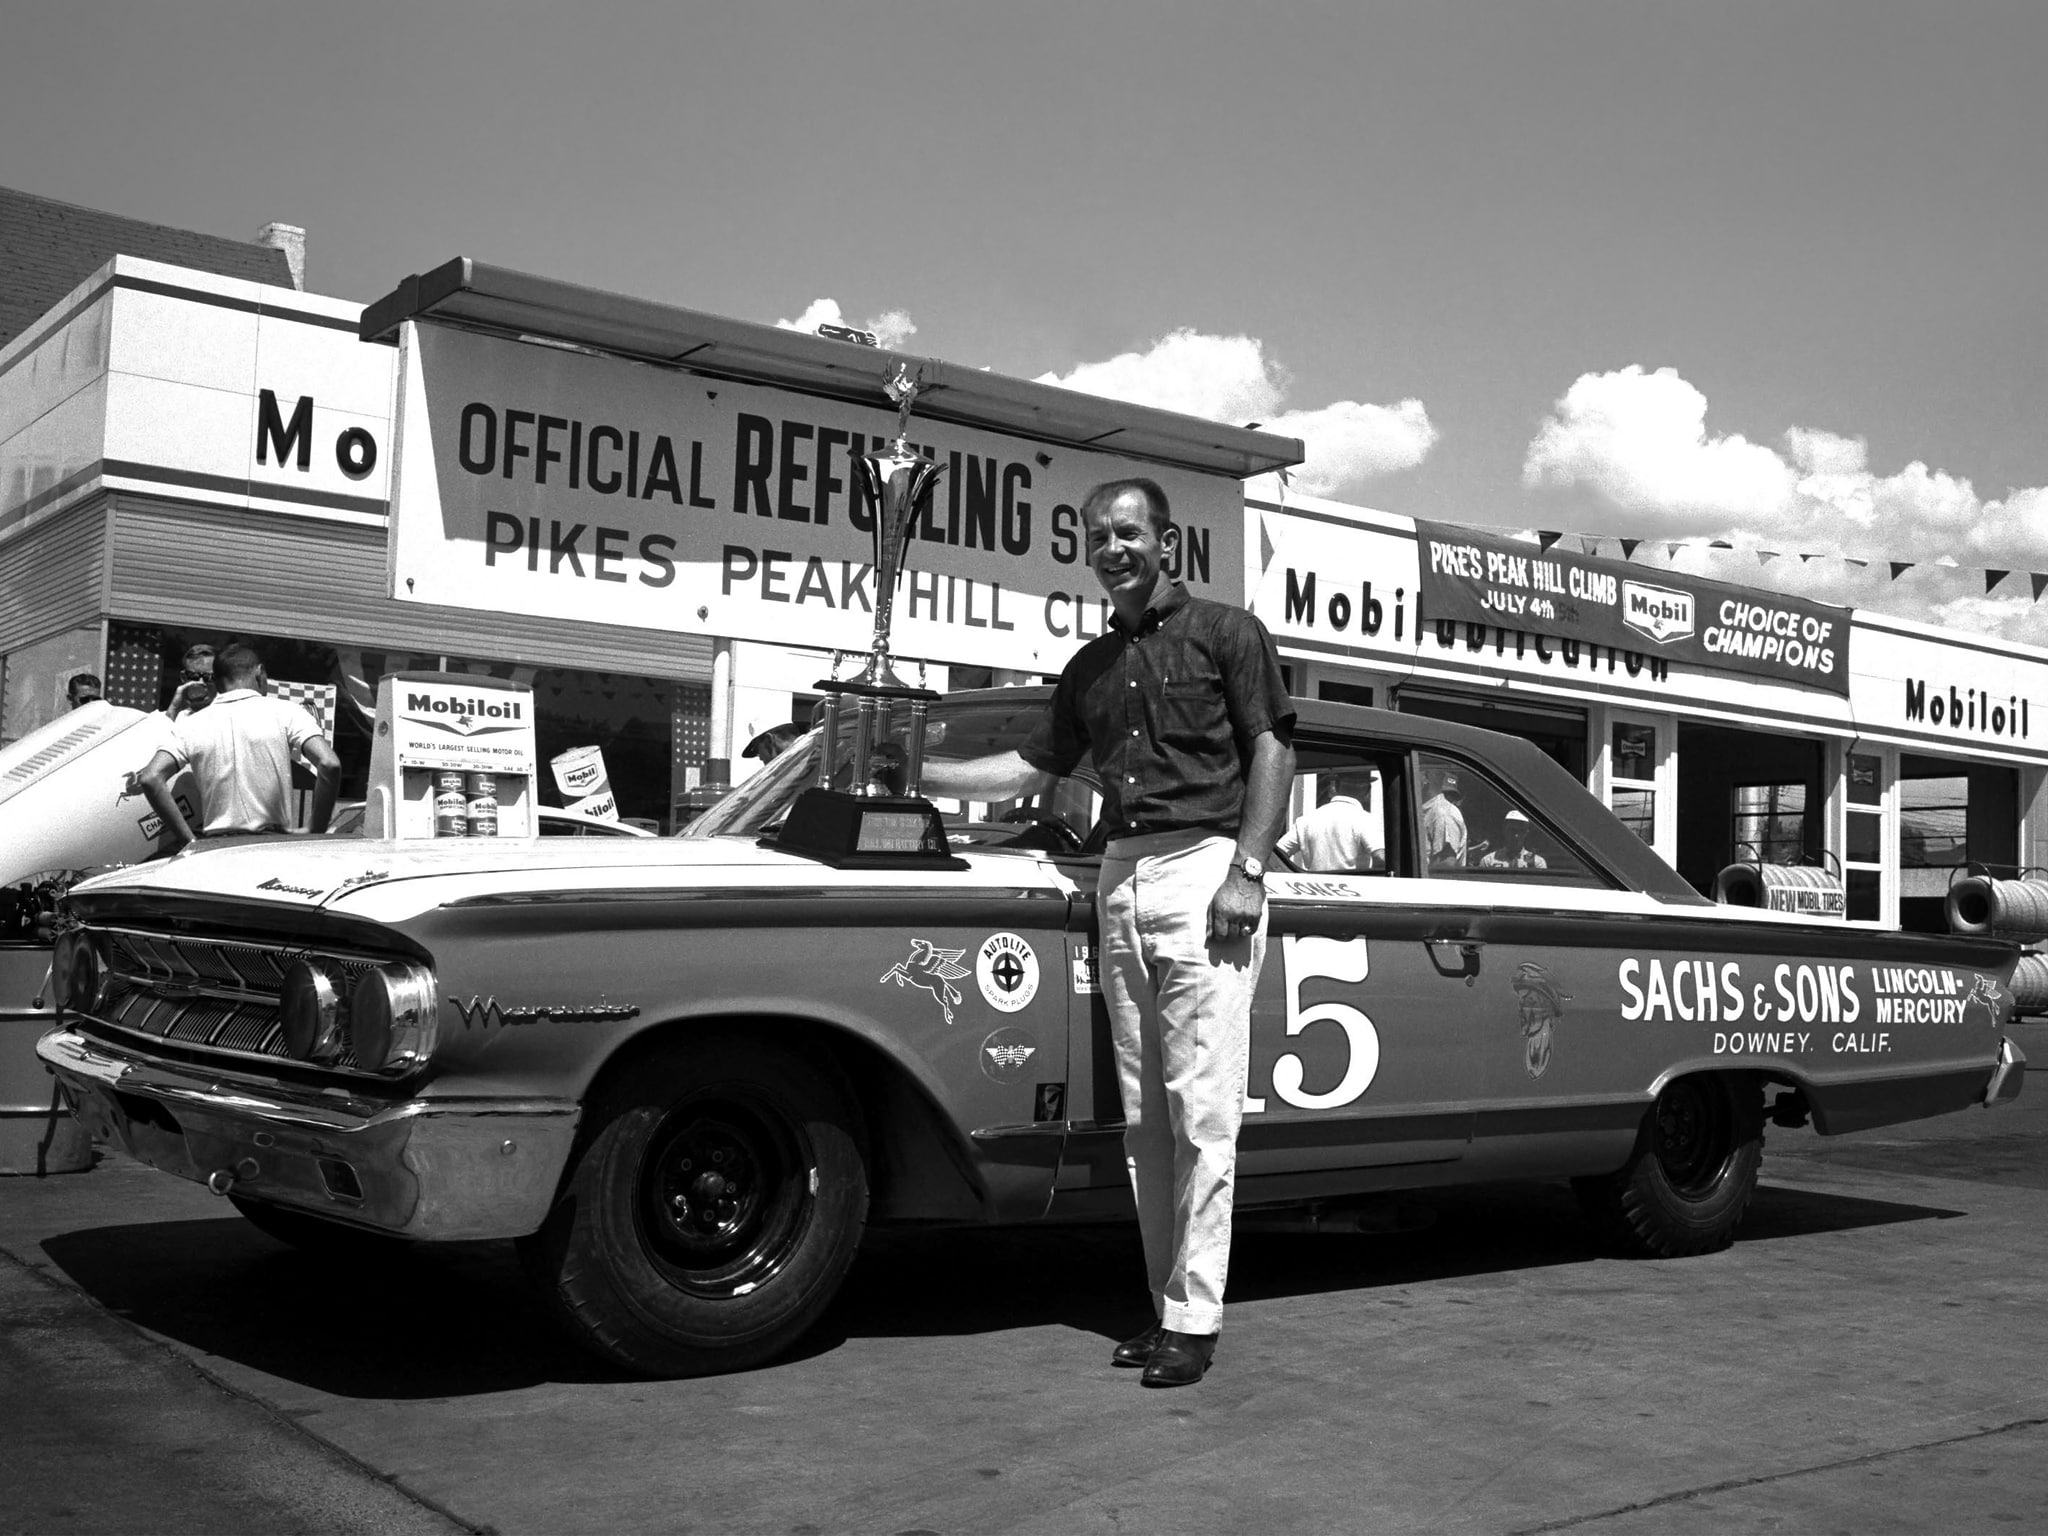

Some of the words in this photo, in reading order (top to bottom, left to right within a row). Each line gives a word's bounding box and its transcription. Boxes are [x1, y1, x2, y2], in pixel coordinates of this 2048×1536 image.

[458, 402, 716, 509] OFFICIAL
[733, 412, 1031, 557] REFULING
[485, 510, 677, 588] PIKES
[722, 544, 874, 613] PEAK
[909, 568, 1014, 631] HILL
[1430, 540, 1483, 580] PIKE'S
[1486, 551, 1529, 588] PEAK
[1532, 559, 1565, 595] HILL
[1569, 566, 1617, 606] CLIMB
[1480, 590, 1527, 615] JULY
[1529, 598, 1555, 620] 4th
[1630, 593, 1687, 622] Mobil
[1719, 599, 1800, 637] CHOICE
[1802, 617, 1832, 644] OF
[1703, 626, 1834, 674] CHAMPIONS
[408, 693, 521, 719] Mobiloil
[1906, 677, 2028, 739] Mobiloil
[409, 742, 436, 750] WORLD'S
[438, 743, 464, 752] LARGEST
[466, 745, 491, 754] SELLING
[492, 747, 512, 756] MOTOR
[513, 749, 524, 757] OIL
[567, 767, 596, 783] Mobil
[1285, 881, 1362, 897] JONES
[1770, 889, 1796, 913] NEW
[1797, 891, 1821, 910] MOBIL
[1822, 892, 1844, 911] TIRES
[983, 936, 1032, 961] AUTOLITE
[984, 983, 1009, 1007] SPARK
[1011, 983, 1034, 1007] PLUGS
[1618, 958, 1745, 1022] SACHS
[1753, 983, 1772, 1022] &
[1774, 963, 1861, 1024] SONS
[1871, 967, 1963, 996] LINCOLN-
[1876, 998, 1967, 1024] MERCURY
[1832, 1032, 1892, 1053] CALIF.
